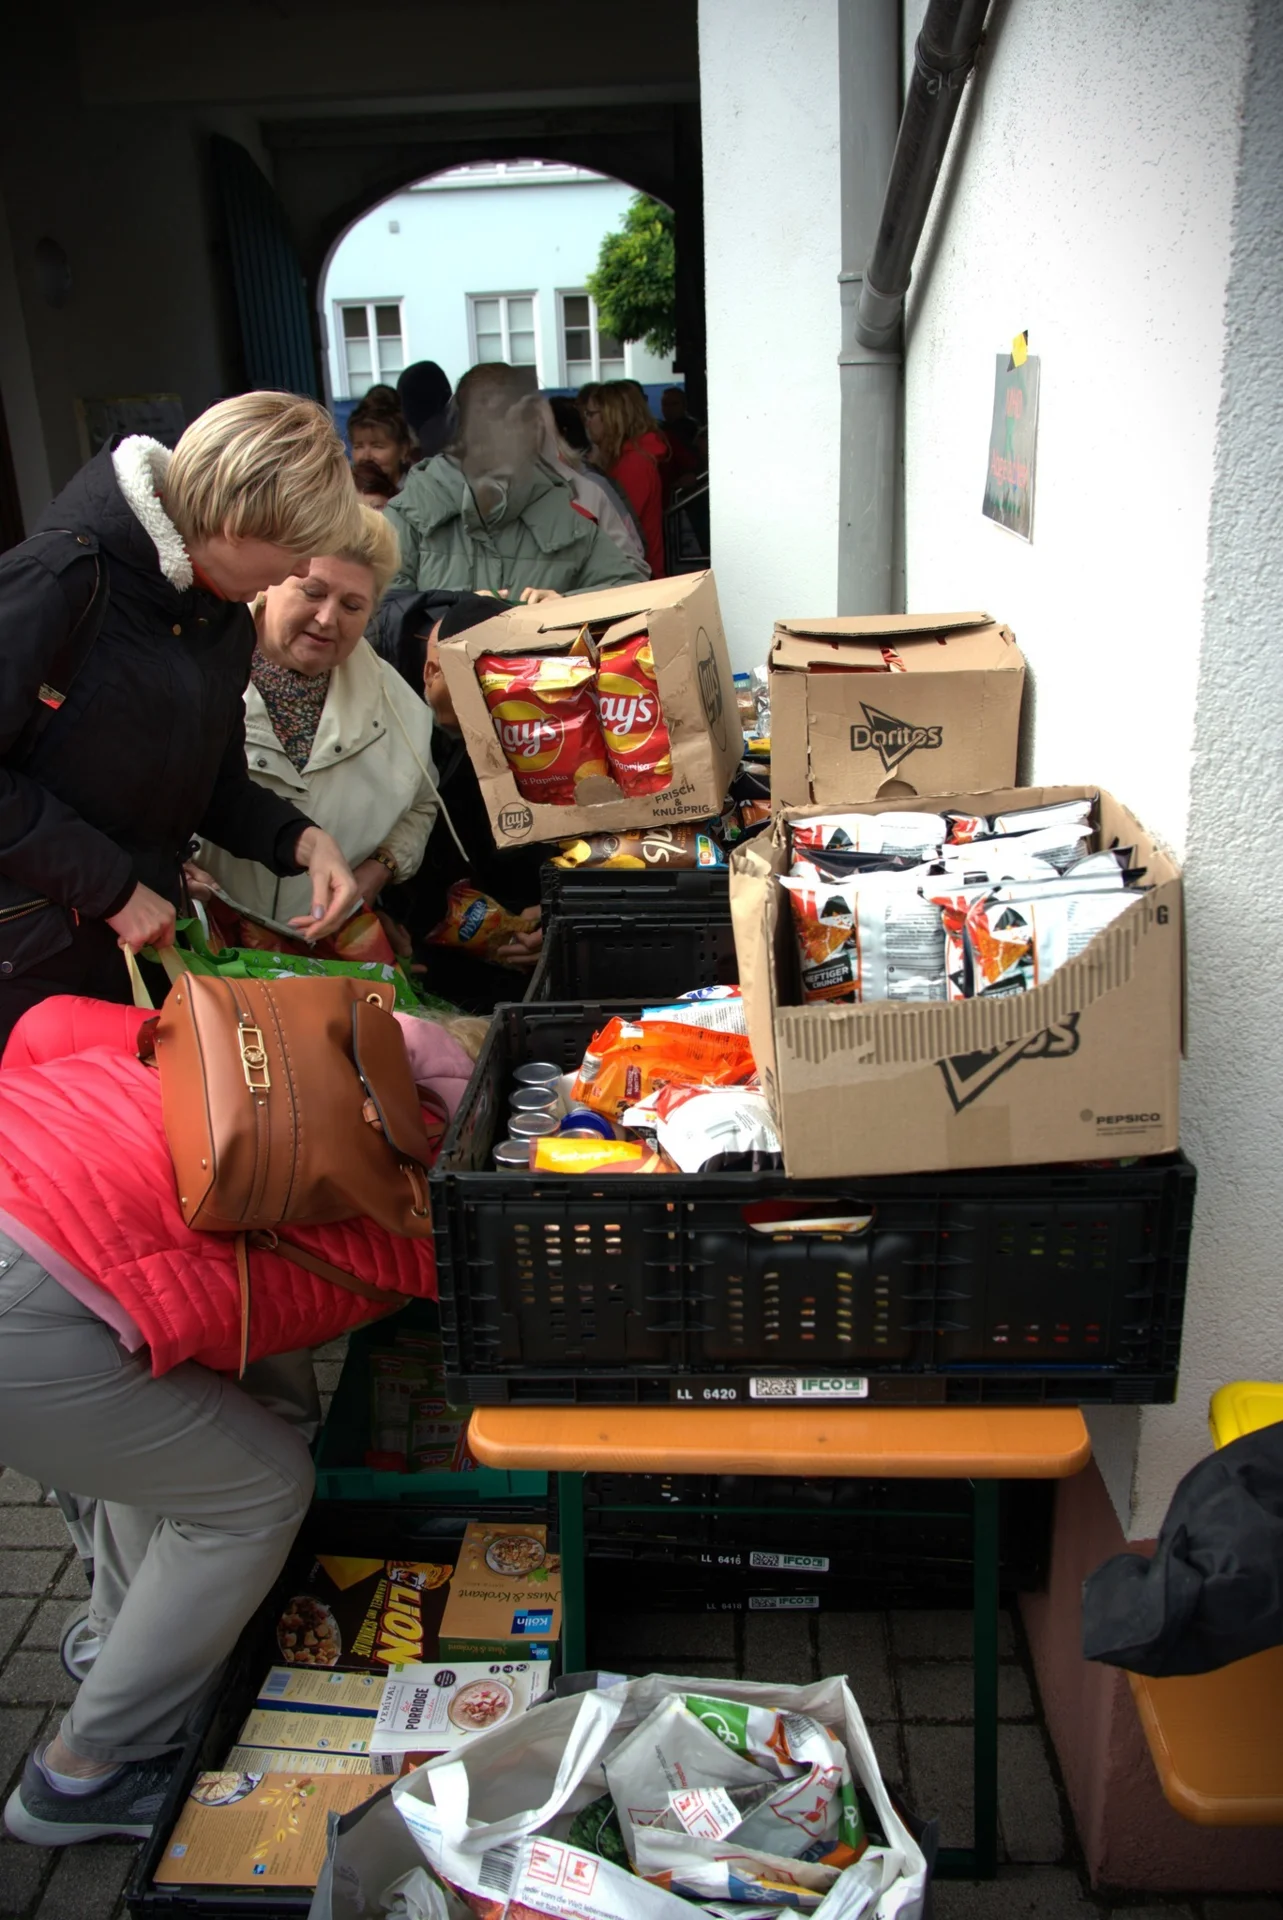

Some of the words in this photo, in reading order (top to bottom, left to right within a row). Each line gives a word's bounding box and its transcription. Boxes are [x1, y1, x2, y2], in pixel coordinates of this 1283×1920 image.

[850, 725, 943, 751] Doritos
[615, 760, 650, 772] Paprika
[529, 774, 568, 786] Paprika
[654, 784, 696, 804] FRISCH
[674, 797, 683, 807] &
[652, 804, 711, 817] KNUSPRIG
[812, 975, 843, 989] CRUNCH
[1096, 1112, 1161, 1125] PEPSICO
[802, 1378, 842, 1391] IFCO
[677, 1388, 693, 1400] LL
[703, 1388, 737, 1400] 6420
[701, 1554, 712, 1563] LL
[783, 1555, 811, 1566] IFCO
[458, 1589, 511, 1602] Krokant
[512, 1591, 524, 1602] &
[527, 1590, 562, 1602] Nuss
[778, 1597, 804, 1605] IFCO
[516, 1617, 549, 1627] Kölln
[405, 1688, 430, 1730] PORRIDGE
